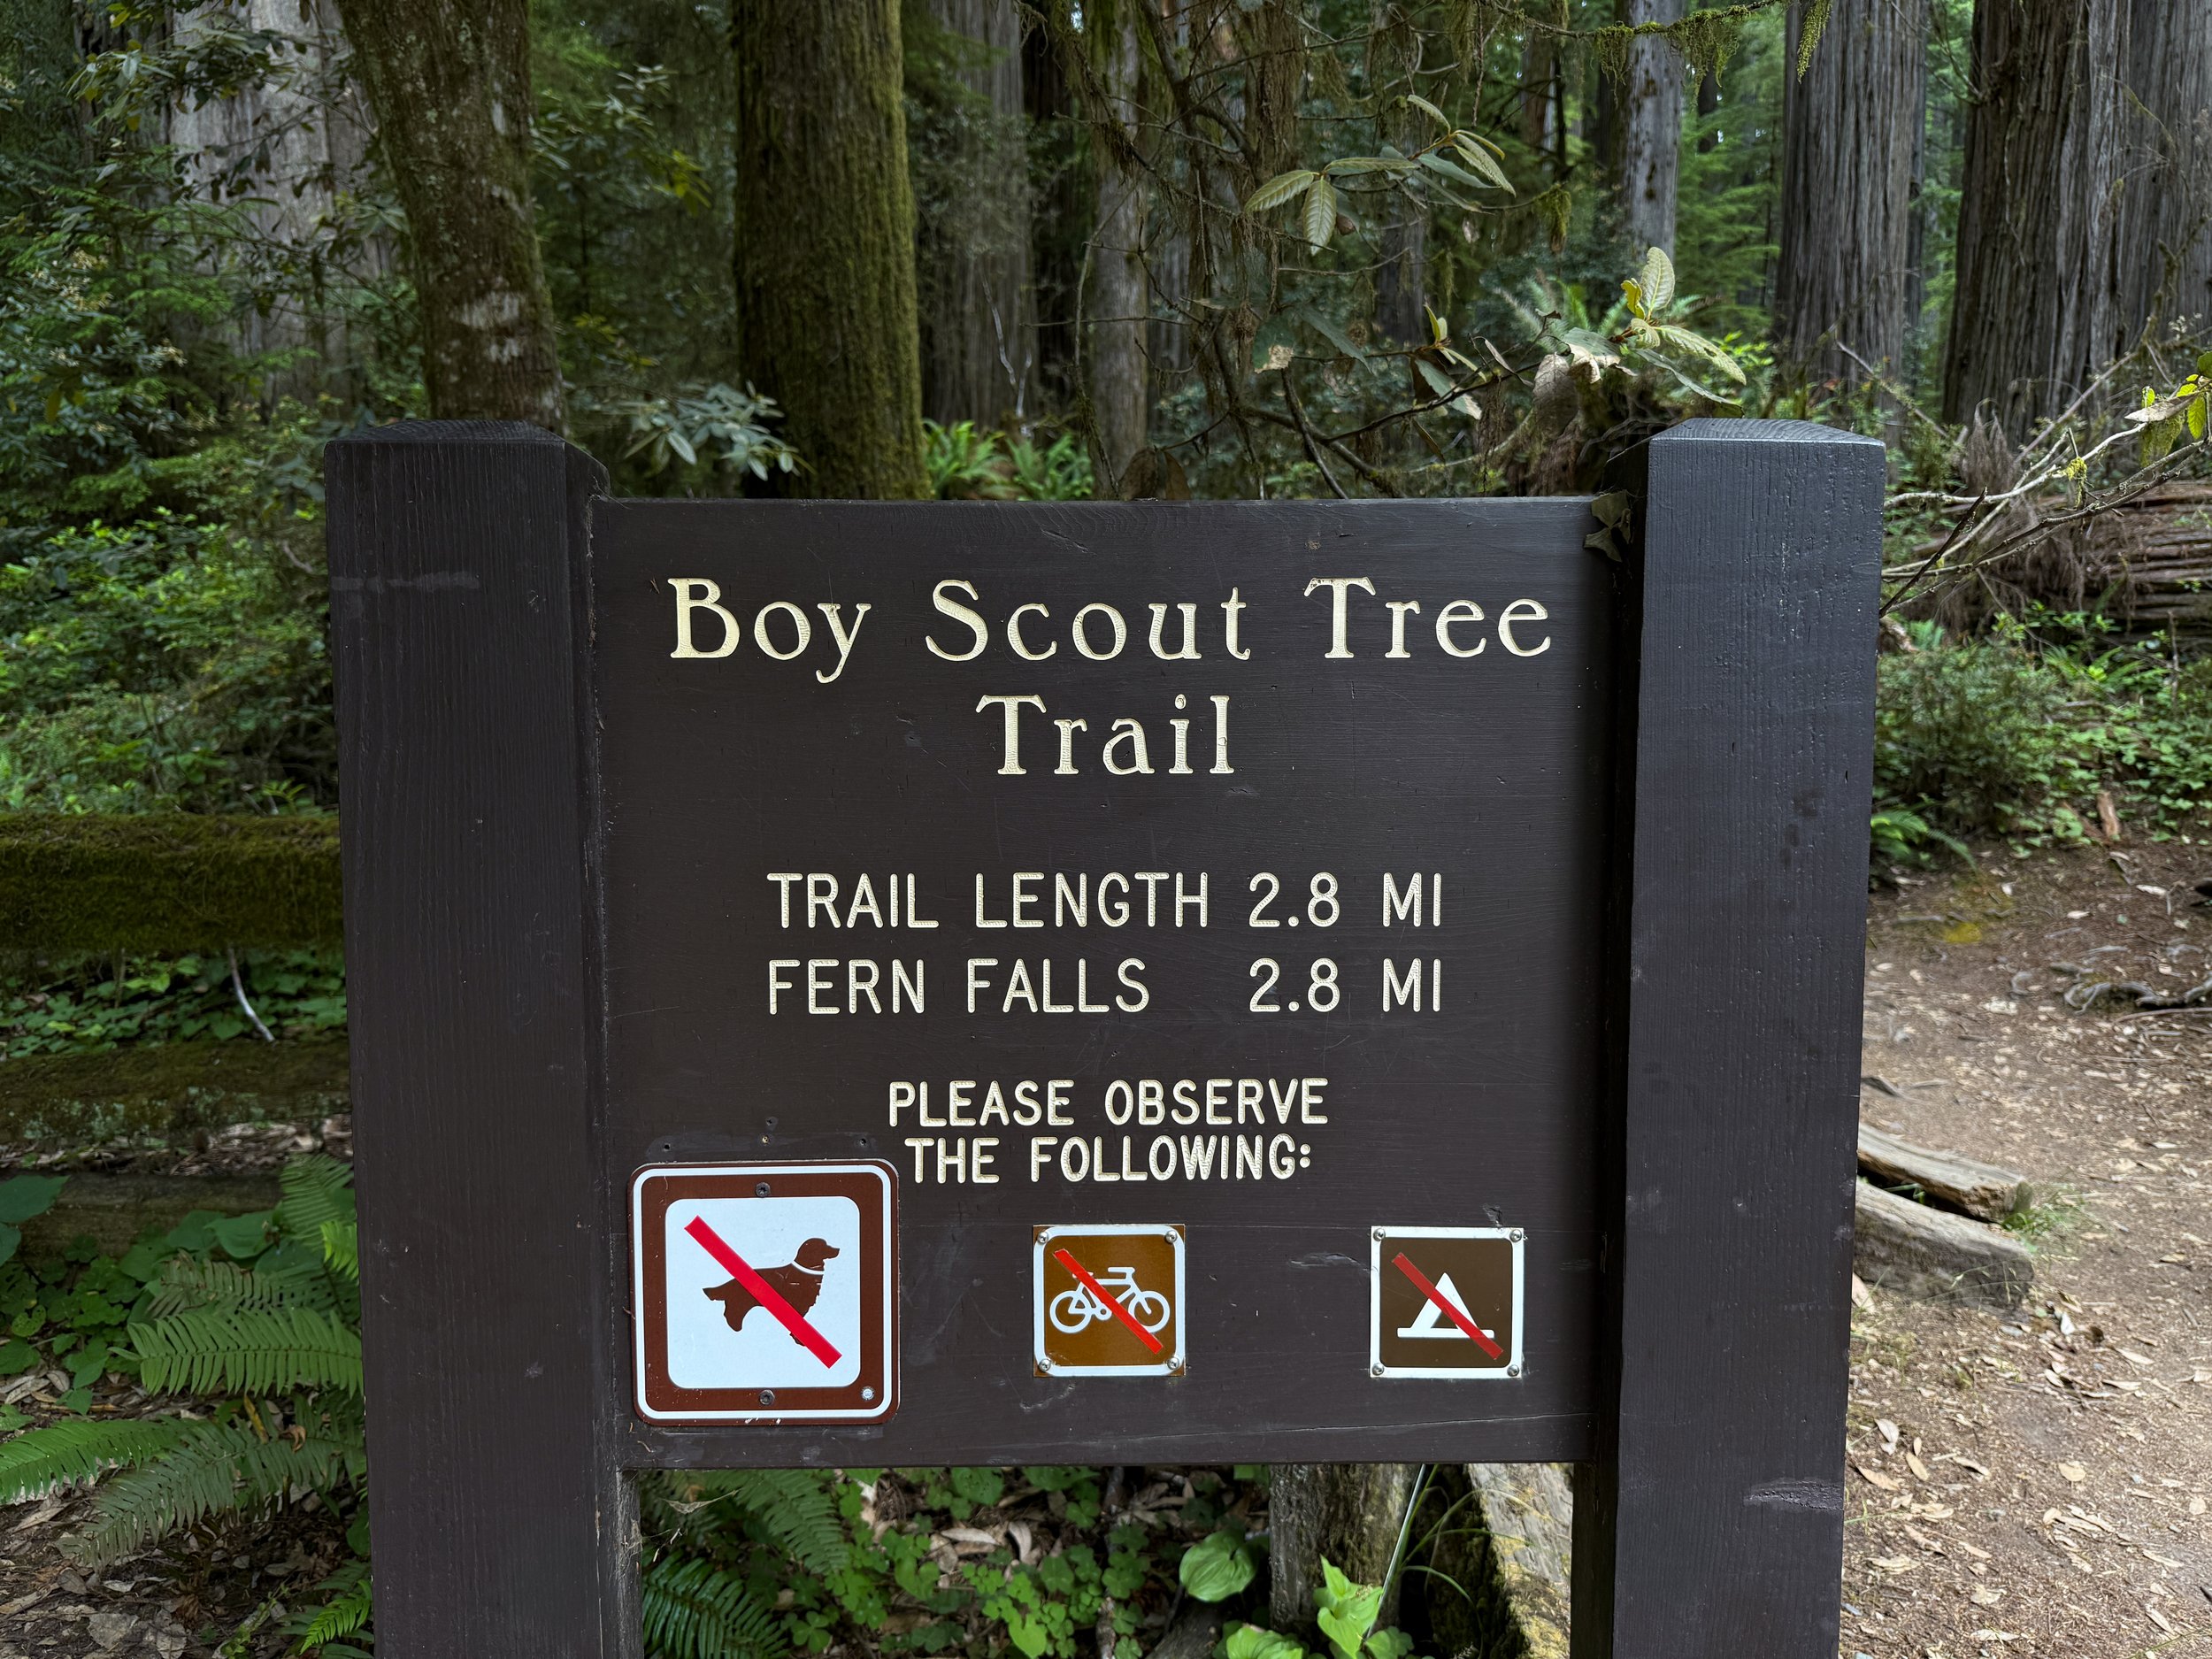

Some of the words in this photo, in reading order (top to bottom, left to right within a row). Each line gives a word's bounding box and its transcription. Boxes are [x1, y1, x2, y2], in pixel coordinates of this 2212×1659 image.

[667, 578, 872, 684] Boy
[925, 578, 1251, 662] Scout
[1303, 576, 1552, 659] Tree
[975, 694, 1236, 775] Trail
[766, 872, 940, 929] TRAIL
[974, 872, 1210, 929] LENGTH
[1248, 871, 1340, 928] 2.8
[1381, 872, 1443, 927] MI
[767, 958, 925, 1015] FERN
[966, 957, 1150, 1014] FALLS
[1248, 957, 1340, 1013] 2.8
[1381, 957, 1442, 1013] MI
[888, 1079, 1075, 1127] PLEASE
[1104, 1077, 1330, 1125] OBSERVE
[903, 1137, 1000, 1184] THE
[1030, 1133, 1312, 1183] FOLLOWING:
